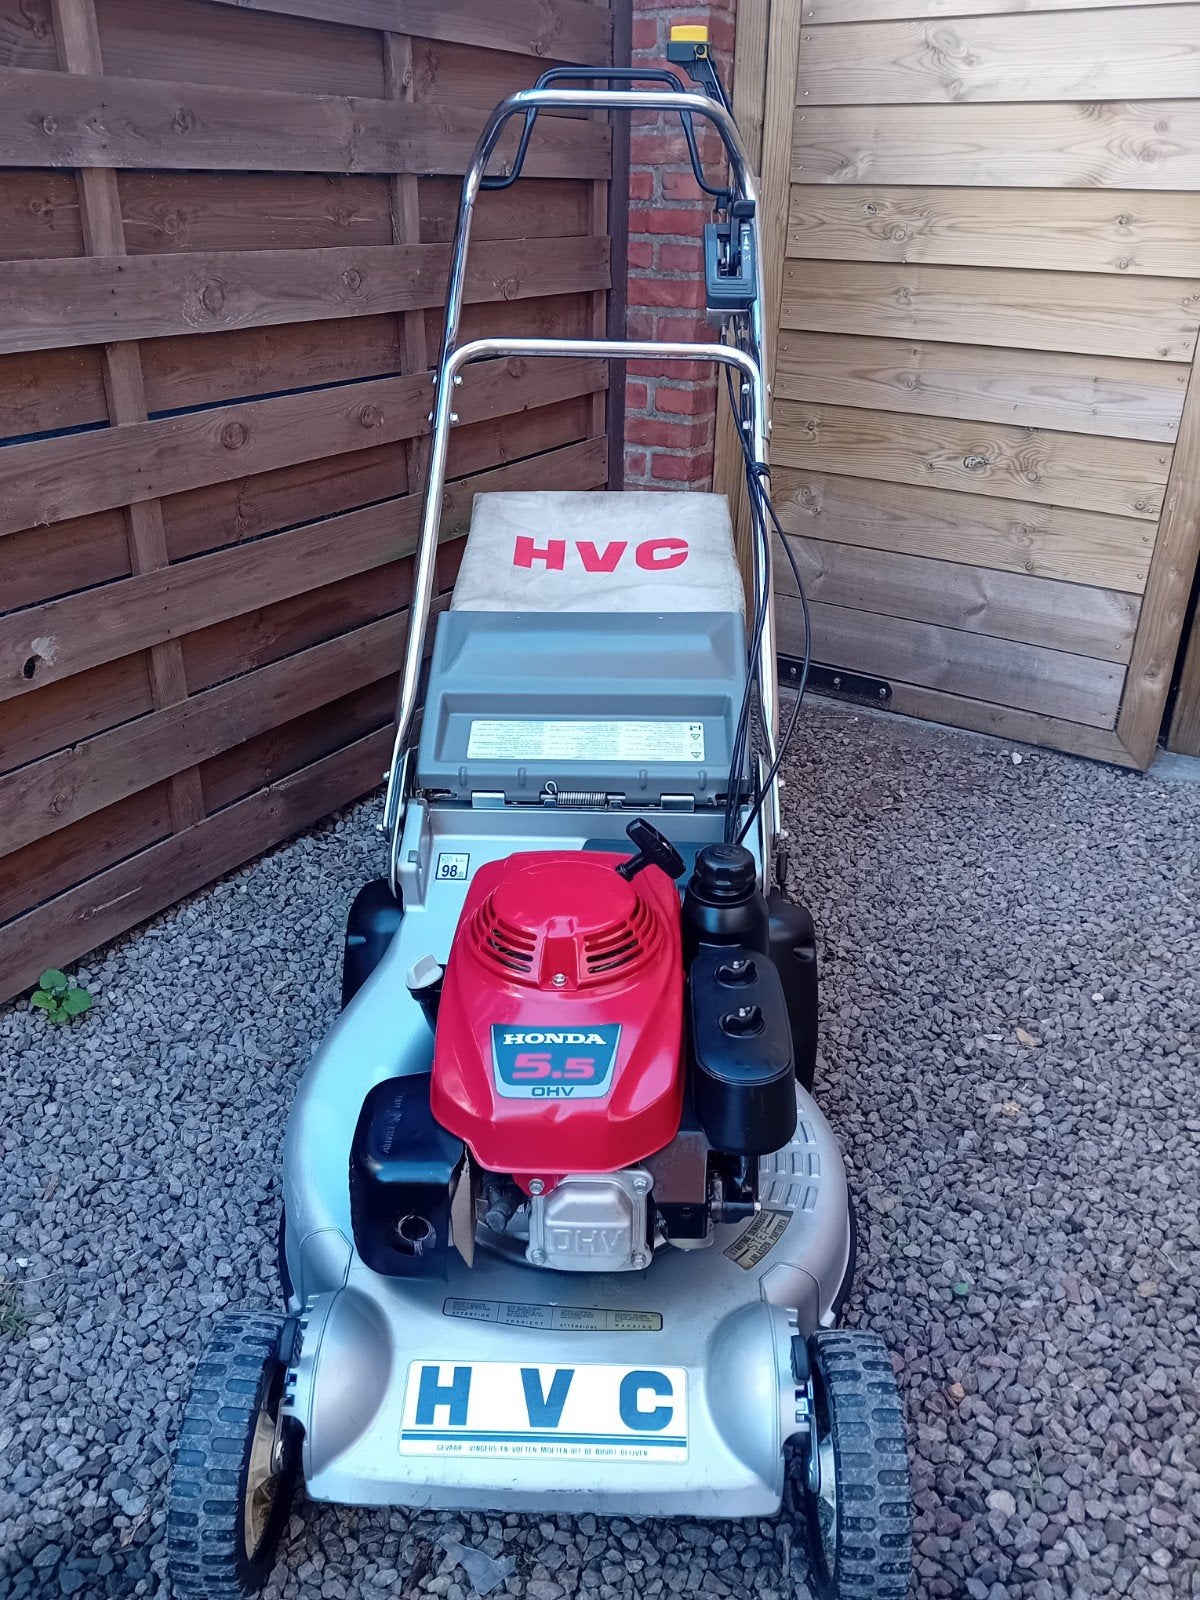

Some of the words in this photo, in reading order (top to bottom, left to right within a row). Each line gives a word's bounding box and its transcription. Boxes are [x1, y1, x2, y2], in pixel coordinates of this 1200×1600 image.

[512, 535, 690, 573] HVC
[441, 864, 458, 878] 98
[502, 1032, 607, 1045] HONDA
[512, 1053, 595, 1079] 5.5
[531, 1086, 575, 1097] OHV
[552, 1228, 624, 1254] OHV
[747, 1226, 770, 1251] STEP
[415, 1365, 674, 1432] HVC
[584, 1447, 592, 1455] DE
